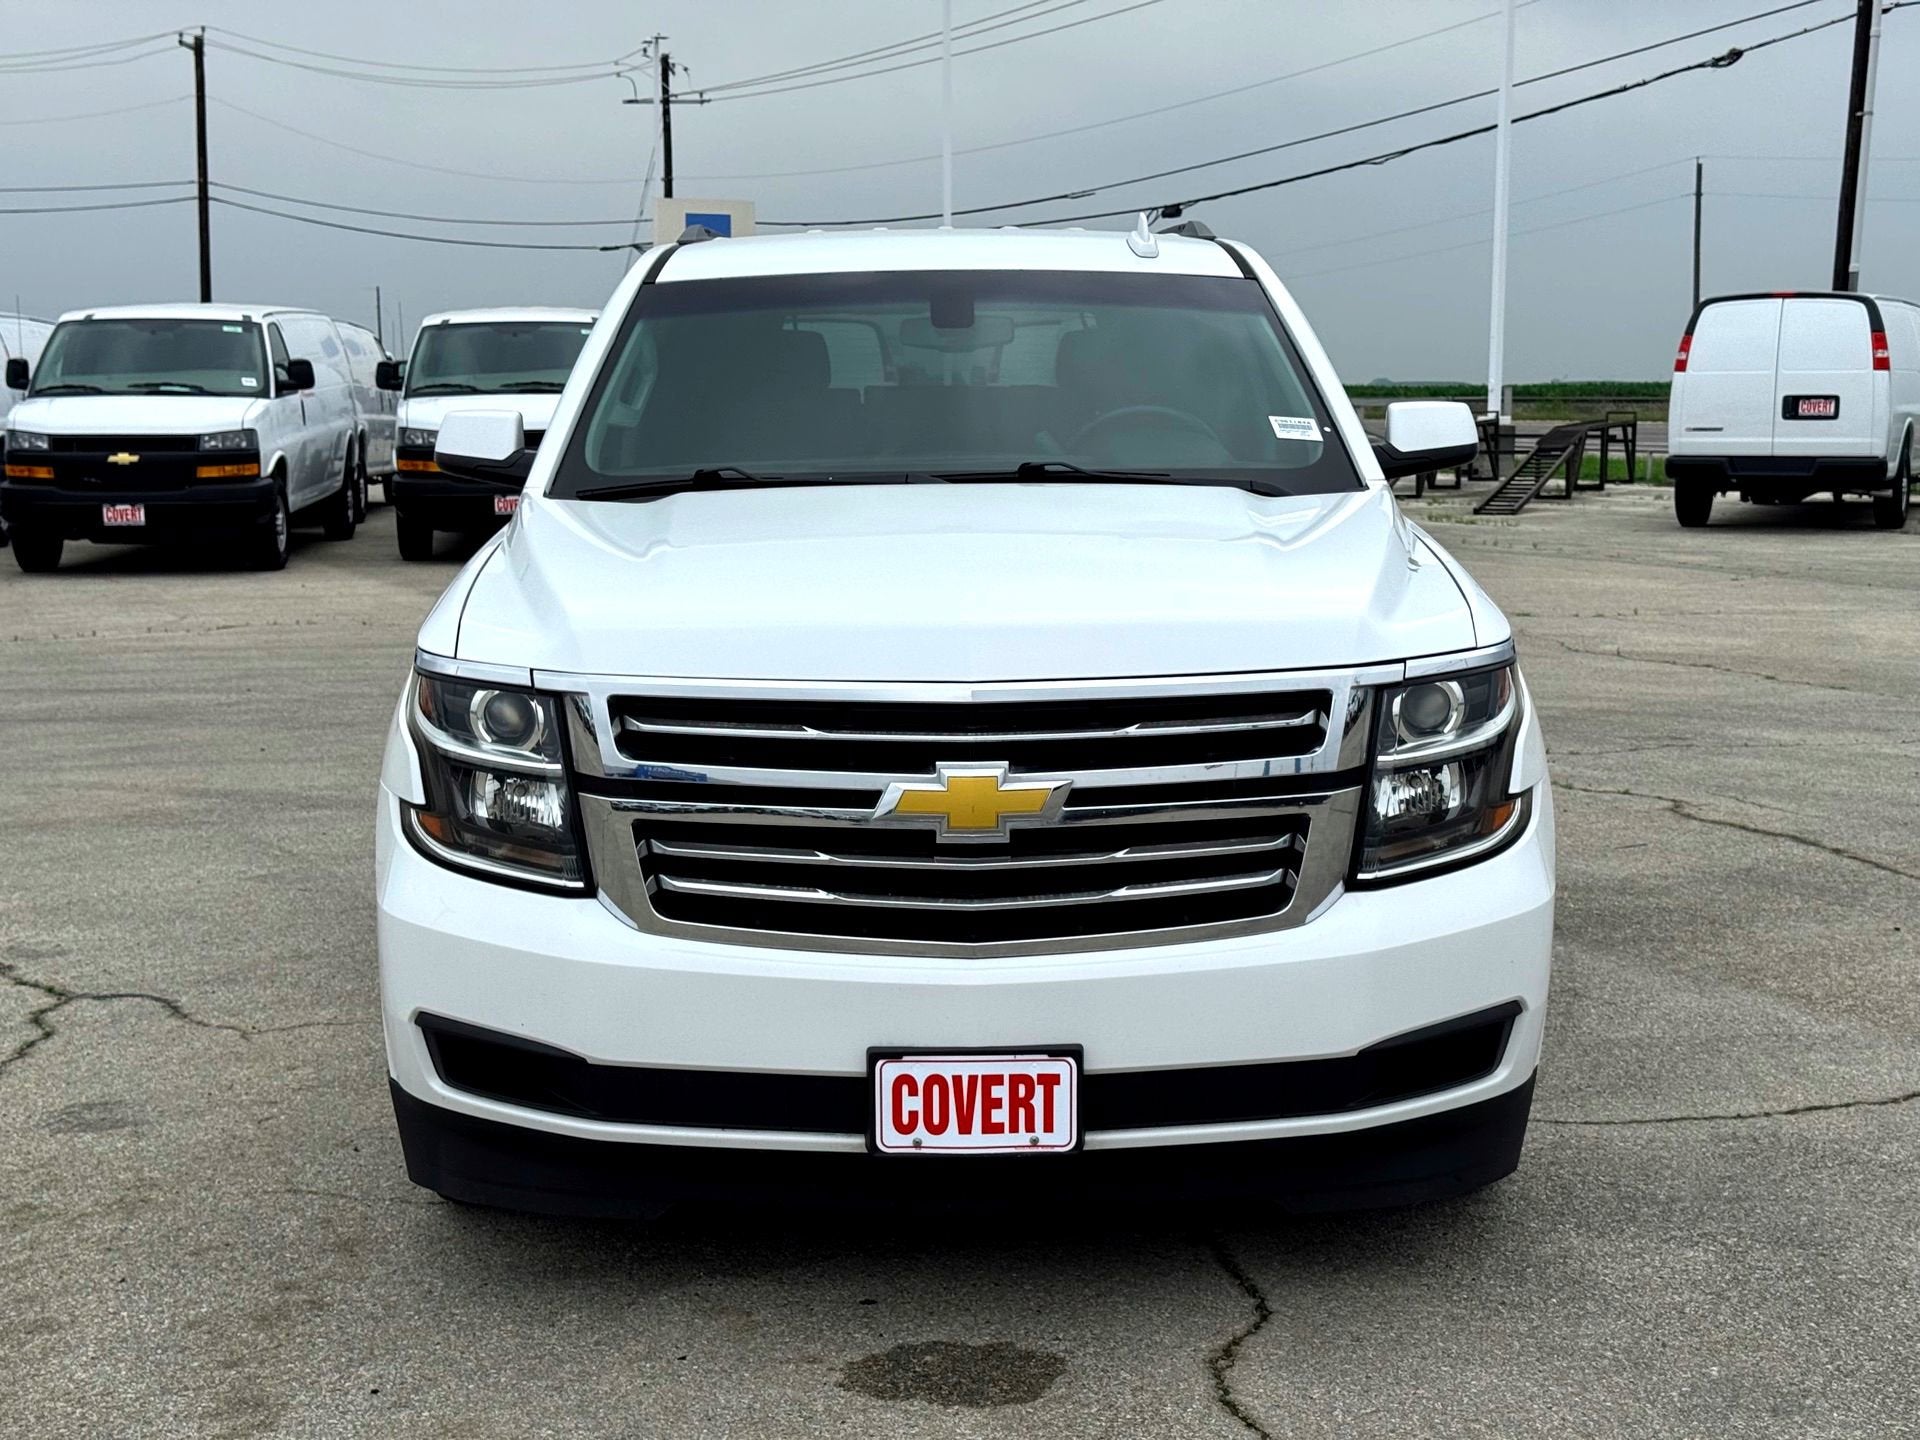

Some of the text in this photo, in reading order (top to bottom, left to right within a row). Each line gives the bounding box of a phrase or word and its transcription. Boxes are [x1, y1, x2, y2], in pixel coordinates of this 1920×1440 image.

[1800, 399, 1833, 413] COVERT
[105, 506, 142, 522] COVERT
[891, 1072, 1061, 1136] COVERT
